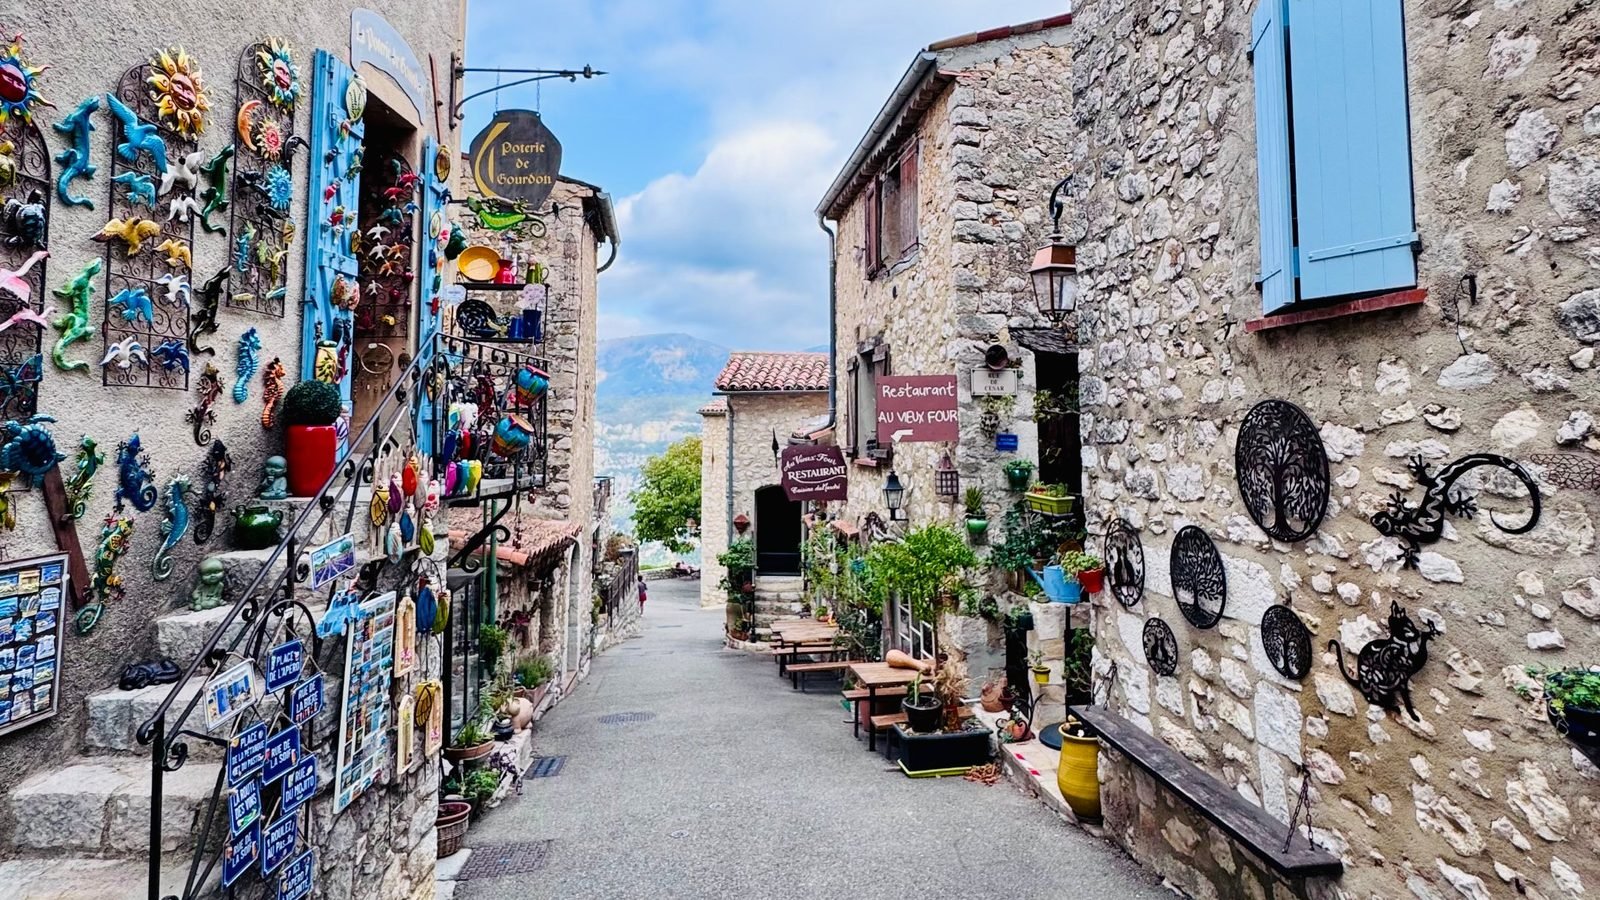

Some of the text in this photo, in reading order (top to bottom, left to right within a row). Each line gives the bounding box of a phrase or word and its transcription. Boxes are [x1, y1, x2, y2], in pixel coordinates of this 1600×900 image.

[501, 141, 546, 156] Poterie
[515, 158, 530, 169] de
[496, 173, 552, 185] Gourdon
[882, 381, 955, 398] Restaurant
[878, 410, 958, 424] AU VIEUX FOUR
[783, 461, 795, 472] Au
[787, 465, 846, 480] RESTAURANT
[276, 650, 294, 666] PLACE
[269, 670, 276, 682] DE
[298, 681, 316, 700] RUE DE
[296, 701, 304, 714] LA
[240, 730, 257, 749] PLACE
[271, 738, 290, 759] RUE DE
[232, 755, 238, 765] DE
[237, 751, 244, 762] LA
[270, 757, 278, 769] LA
[294, 766, 306, 783] RUE
[232, 778, 256, 807] LA ROUTE
[285, 776, 315, 803] DU MOJITO
[234, 792, 257, 821] DES VINS
[270, 819, 292, 844] ROULEZ
[233, 831, 252, 856] RUE DE
[267, 844, 275, 860] AU
[232, 854, 240, 868] LA
